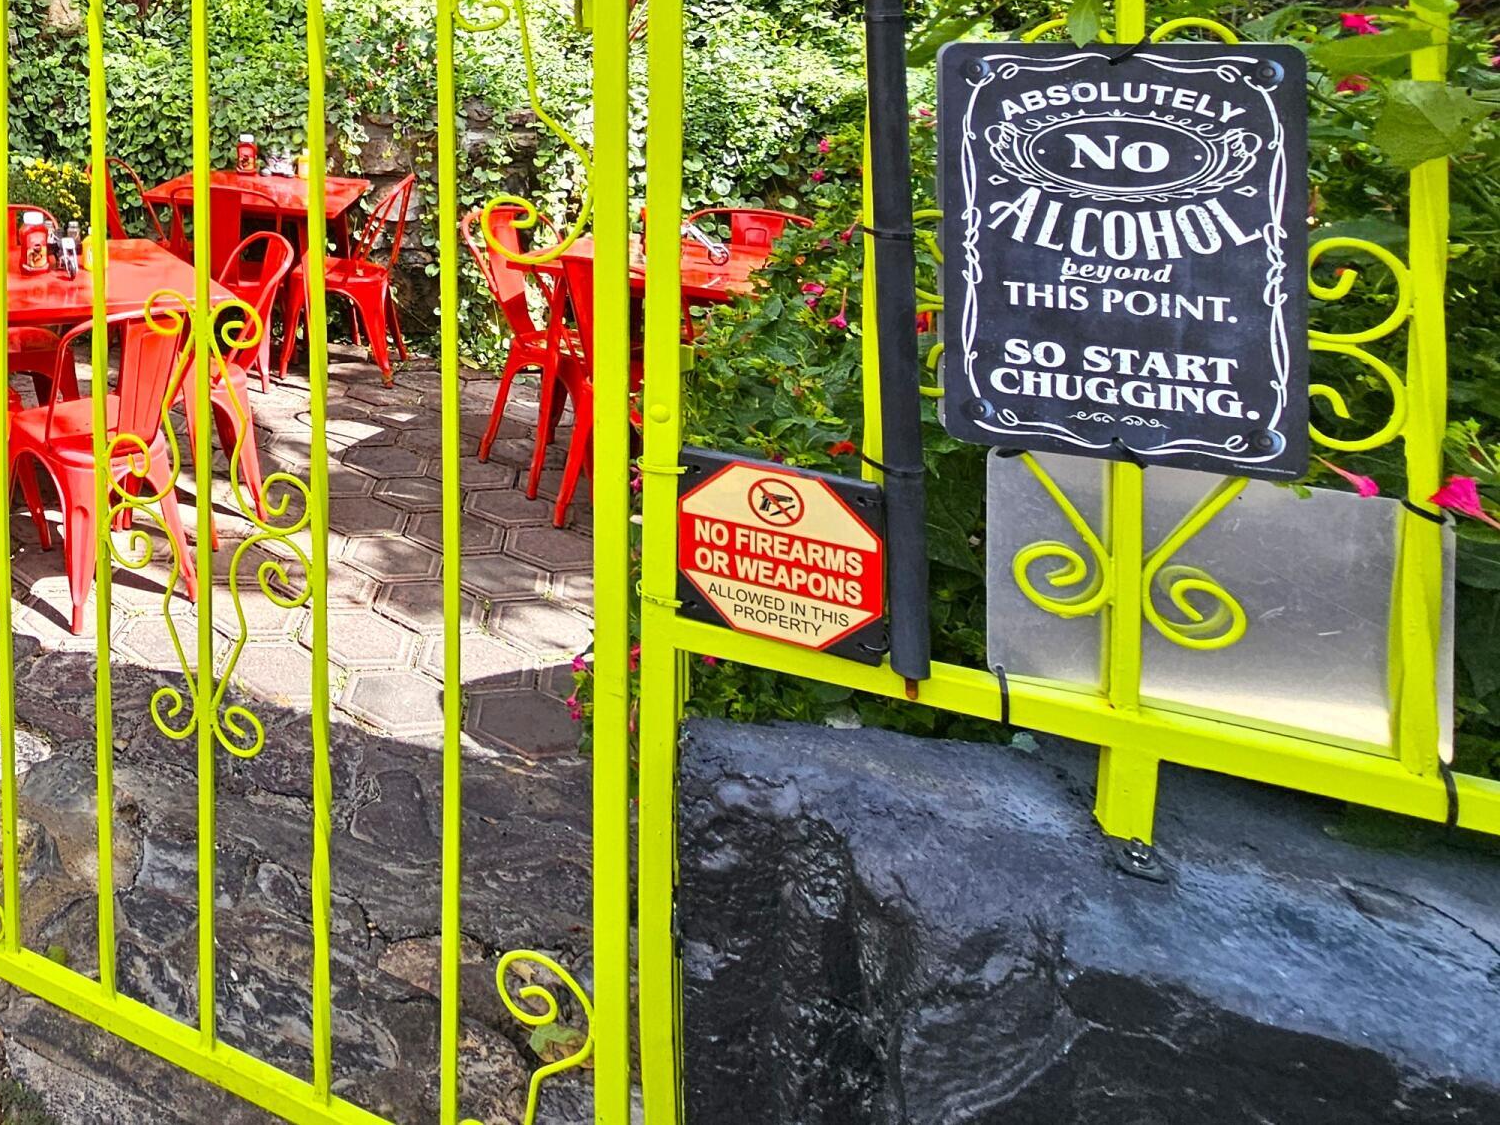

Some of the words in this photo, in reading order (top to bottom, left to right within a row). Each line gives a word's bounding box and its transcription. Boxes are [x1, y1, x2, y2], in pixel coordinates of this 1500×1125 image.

[1000, 82, 1246, 124] ABSOLUTELY
[988, 186, 1263, 261] ALCOHOL
[1060, 257, 1173, 284] beyond
[1003, 280, 1089, 311] THIS
[1102, 288, 1238, 324] POINT.
[1004, 338, 1066, 368] SO
[1082, 346, 1239, 385] START
[989, 367, 1261, 421] CHUGGING.
[694, 518, 730, 547] NO
[735, 527, 864, 577] FIREARMS
[694, 547, 731, 576] OR
[734, 555, 863, 606] WEAPONS
[707, 582, 786, 612] ALLOWED
[790, 601, 806, 617] IN
[811, 605, 850, 627] THIS
[733, 603, 822, 637] PROPERTY
